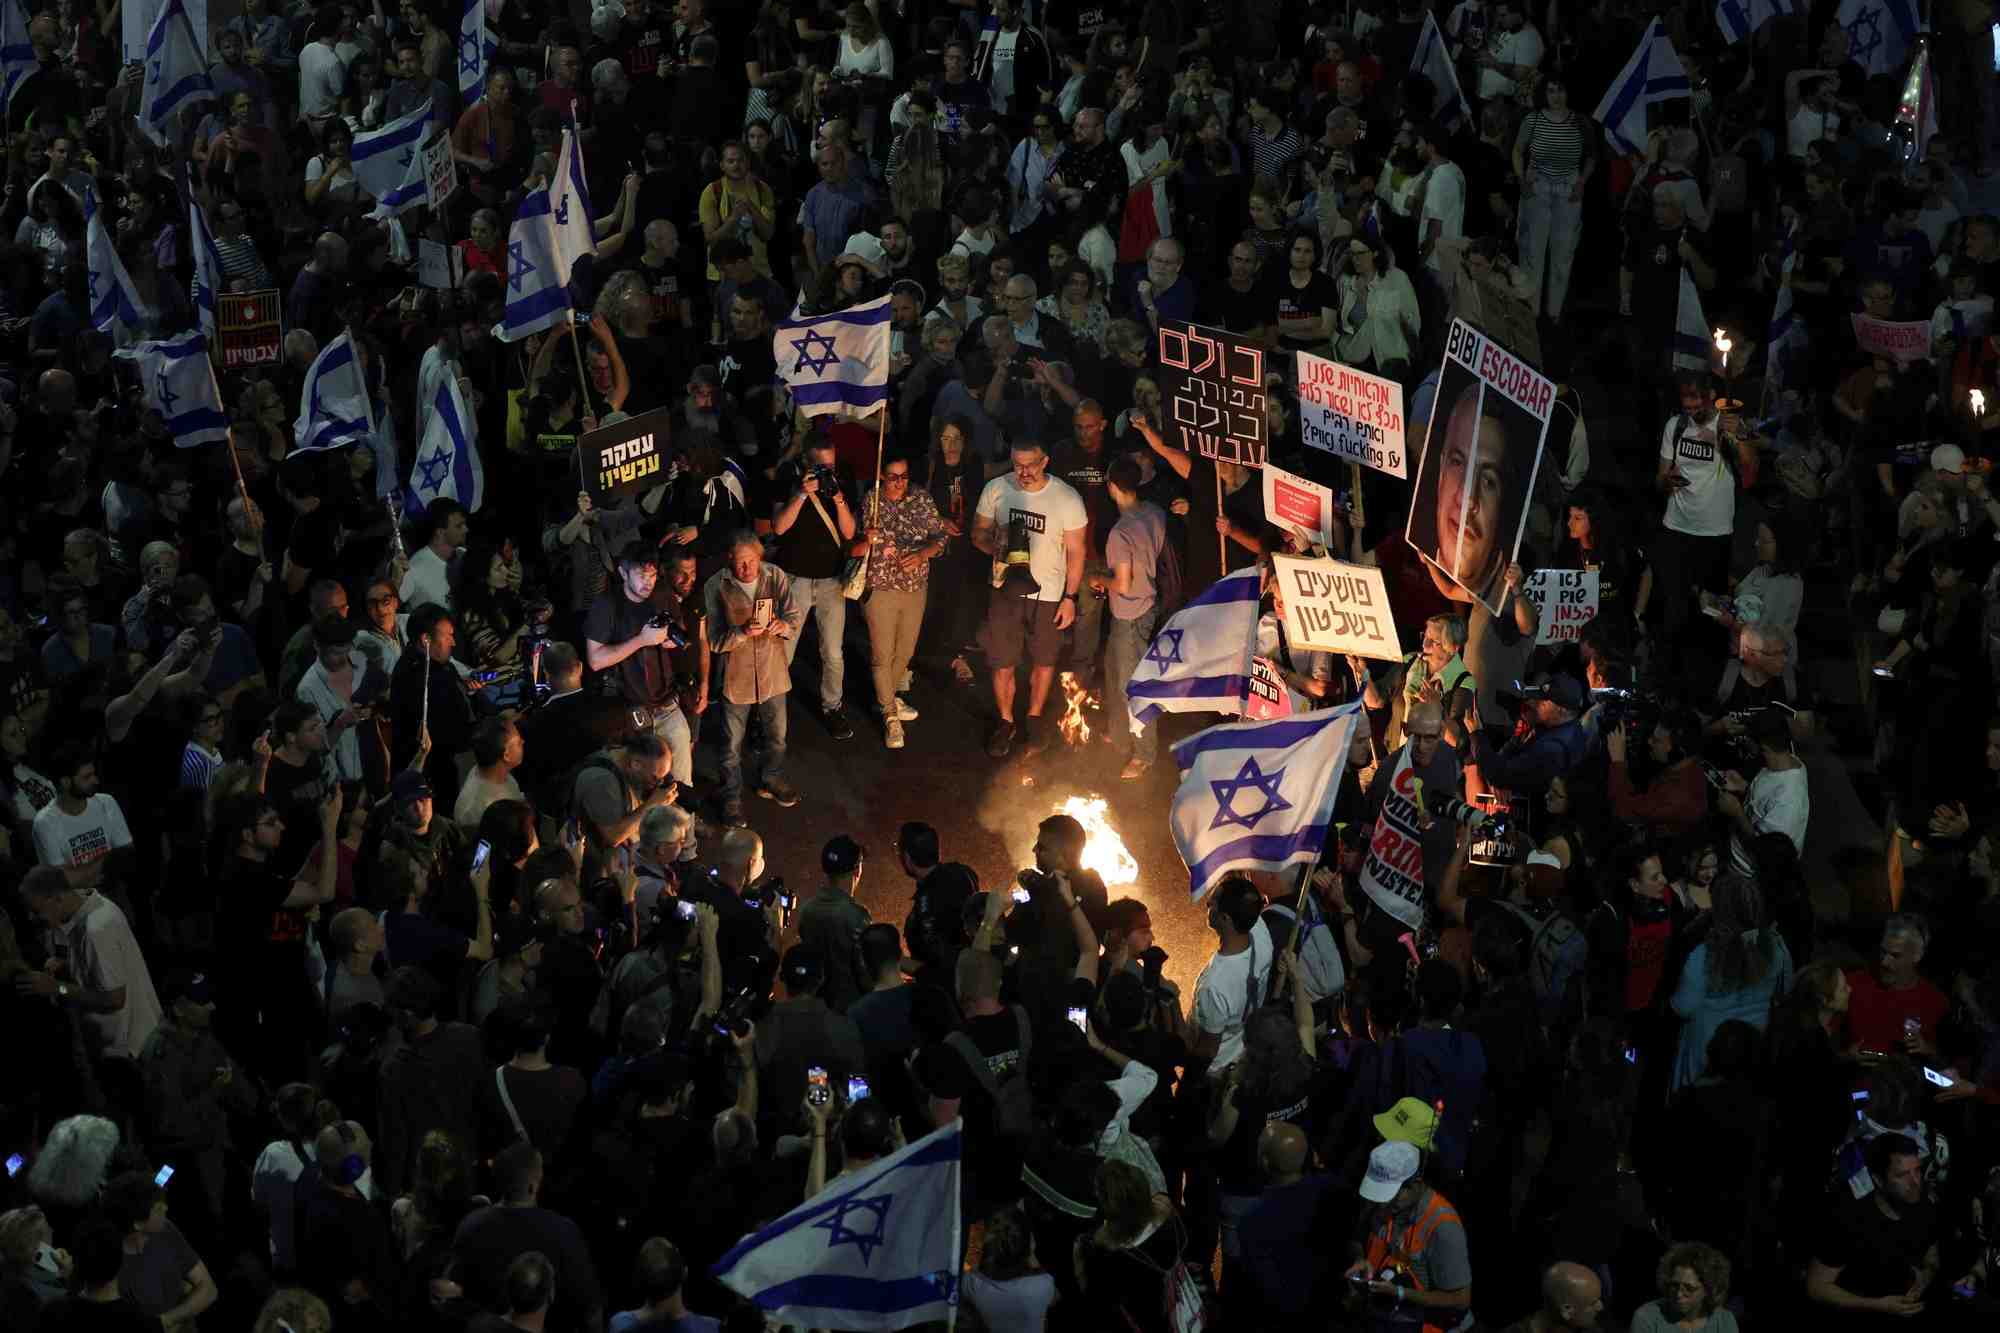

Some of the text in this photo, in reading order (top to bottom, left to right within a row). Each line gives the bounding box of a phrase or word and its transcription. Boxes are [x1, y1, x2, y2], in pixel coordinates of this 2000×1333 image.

[1160, 326, 1262, 387] כולם
[1307, 361, 1334, 386] שלנו
[1448, 322, 1553, 418] BIBI ESCOBAR
[1174, 395, 1260, 441] כולם
[1323, 409, 1385, 444] ואתם רבים
[1357, 401, 1373, 422] לא
[600, 433, 654, 468] עסקה
[1180, 425, 1265, 469] עכשיו
[1338, 434, 1384, 468] fucking
[600, 453, 660, 490] עכשיו!
[1293, 569, 1373, 606] פושעים
[1295, 601, 1385, 641] בשלטון
